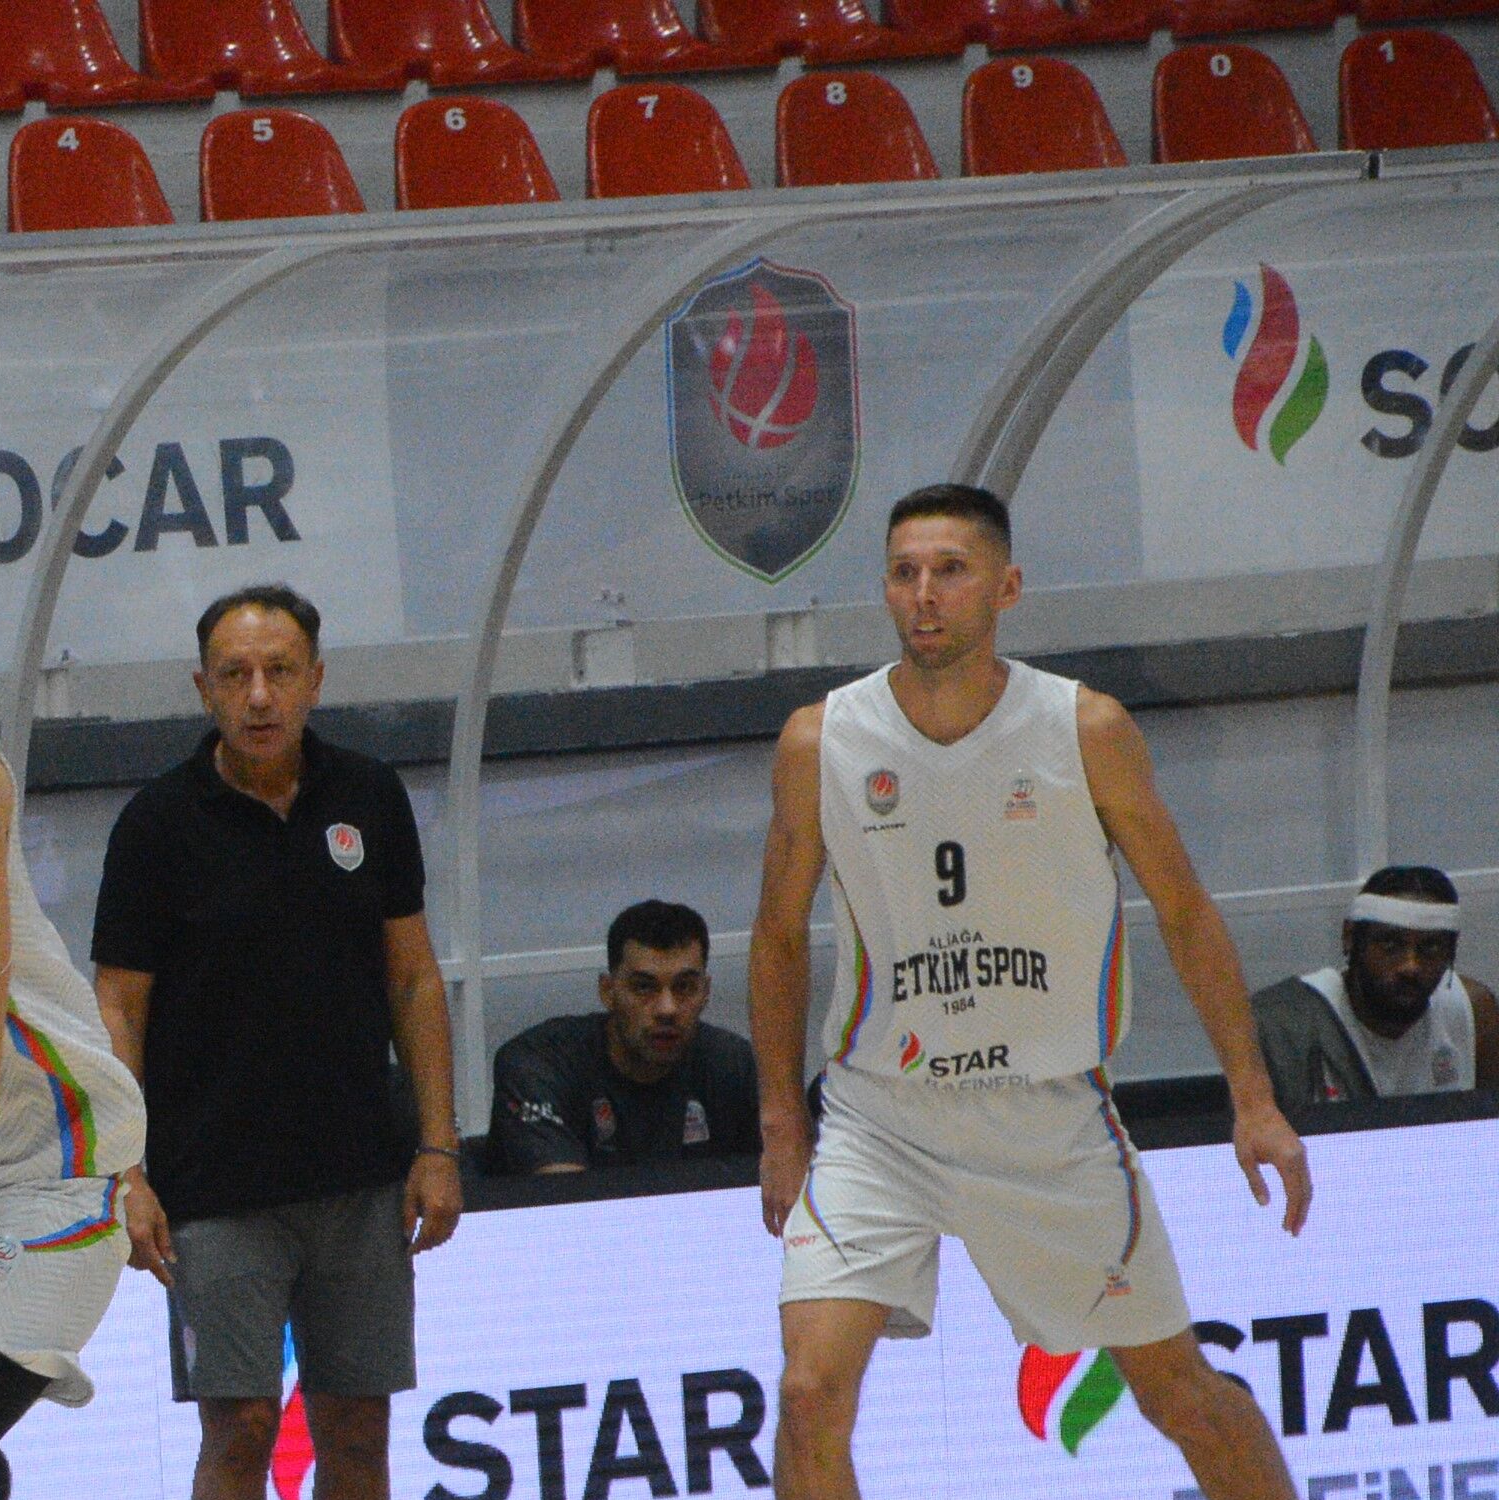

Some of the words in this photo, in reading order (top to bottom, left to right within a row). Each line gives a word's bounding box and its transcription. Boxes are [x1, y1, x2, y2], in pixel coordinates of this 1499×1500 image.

[1011, 65, 1033, 88] 9
[825, 81, 847, 105] 8
[443, 107, 467, 131] 6
[637, 95, 659, 119] 7
[57, 128, 80, 151] 4
[252, 119, 274, 142] 5
[934, 840, 967, 908] 9
[976, 946, 1049, 992] SPOR
[929, 1044, 1010, 1078] STAR
